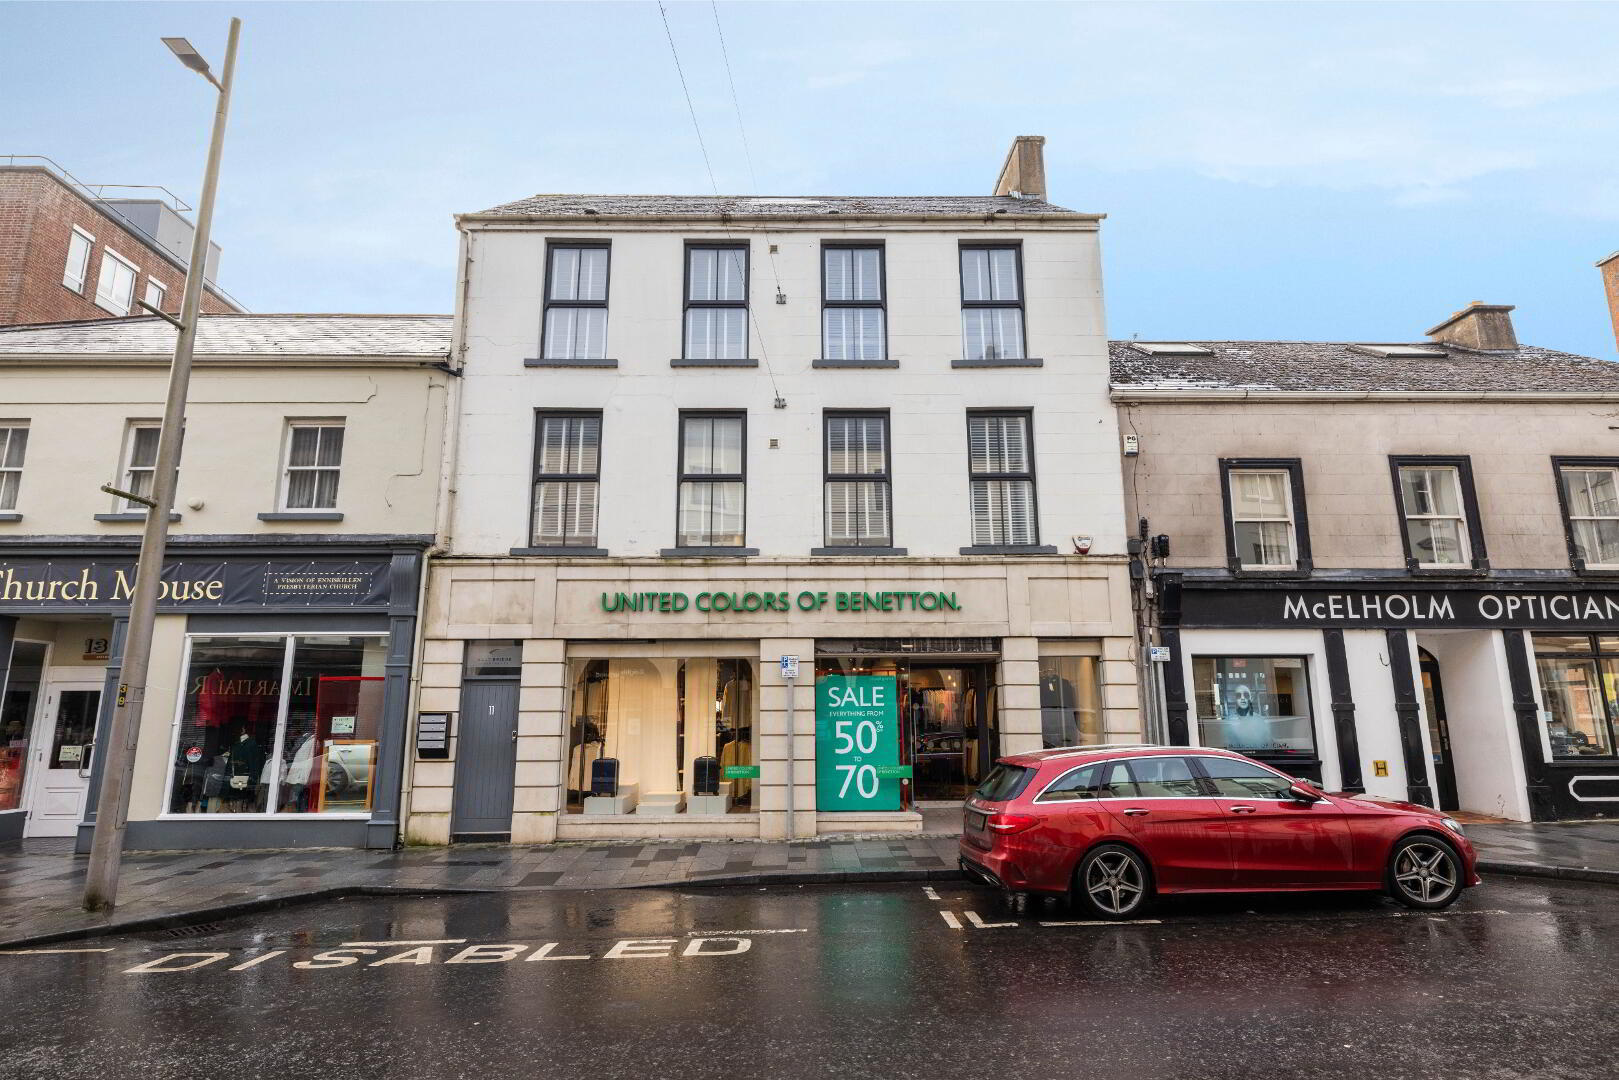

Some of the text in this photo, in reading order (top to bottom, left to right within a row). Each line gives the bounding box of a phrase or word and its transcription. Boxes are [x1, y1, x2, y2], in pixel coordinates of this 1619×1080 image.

[0, 568, 98, 600] hurch
[602, 591, 962, 612] UNITED COLORS OF BENETTON.
[1283, 594, 1455, 620] McELHOLM
[84, 639, 108, 653] 13
[828, 686, 885, 707] SALE
[835, 764, 879, 799] 70
[121, 938, 752, 973] DISABLED
